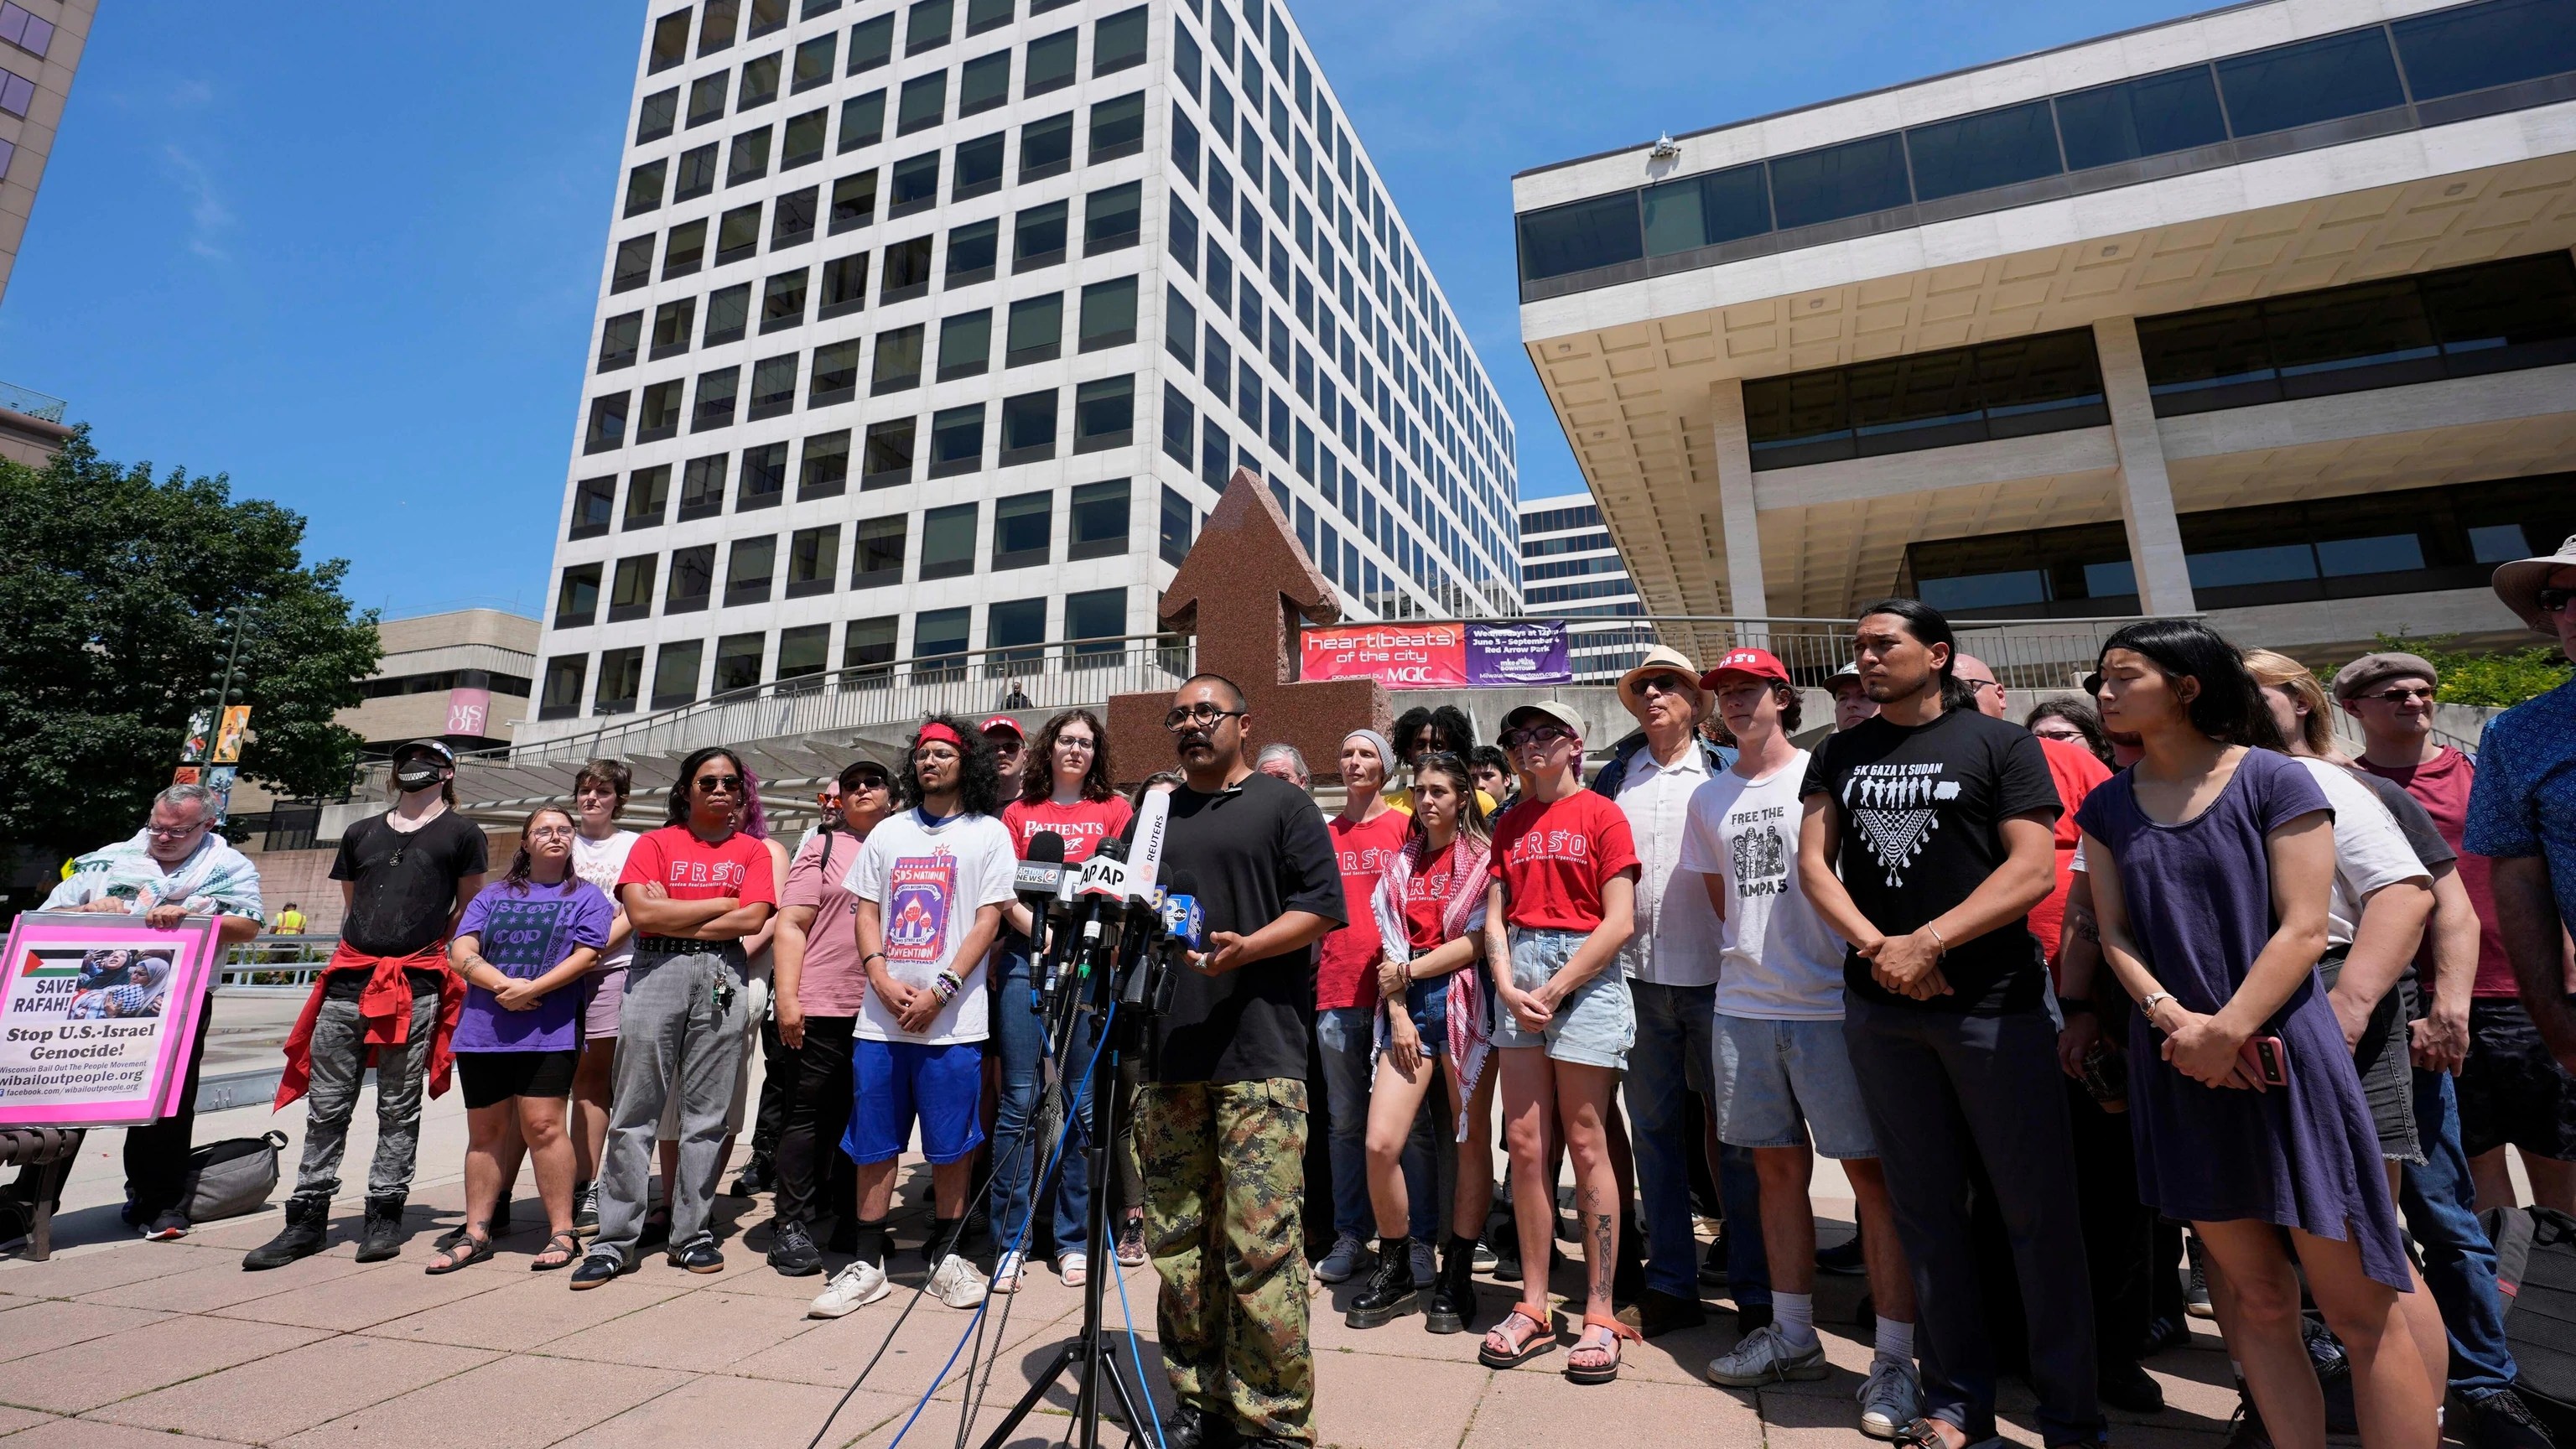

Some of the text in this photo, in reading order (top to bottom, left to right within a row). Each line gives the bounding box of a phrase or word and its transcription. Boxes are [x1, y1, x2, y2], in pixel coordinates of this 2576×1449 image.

[1308, 631, 1456, 650] heart(beats)
[1508, 637, 1553, 647] September
[1336, 649, 1428, 663] of the city
[1332, 673, 1371, 681] powered
[1387, 667, 1433, 682] MGIC
[1853, 763, 1944, 776] 5K GAZA X SUDAN
[1732, 807, 1784, 825] FREE THE
[1023, 820, 1104, 838] PATIENTS
[1147, 814, 1164, 862] REUTERS
[670, 860, 745, 885] FRSO
[893, 870, 946, 883] SDS NATIONAL
[1018, 867, 1046, 875] ACTION
[1080, 865, 1098, 886] AP
[1098, 865, 1124, 886] AP
[1016, 875, 1043, 883] NEWS
[1778, 879, 1789, 894] 5
[496, 902, 558, 914] STOP
[493, 929, 542, 944] COP
[886, 945, 935, 958] CONVENTION
[35, 979, 76, 994] SAVE
[13, 997, 70, 1013] RAFAH!
[6, 1023, 156, 1044] Stop U.S.-Israel
[30, 1043, 126, 1060] Genocide!
[38, 1064, 53, 1072] Bail
[83, 1062, 108, 1070] People
[110, 1060, 147, 1068] Movement
[0, 1069, 144, 1087] wibailoutpeople.org
[6, 1083, 138, 1096] facebook.com/wibailoutpeople.org
